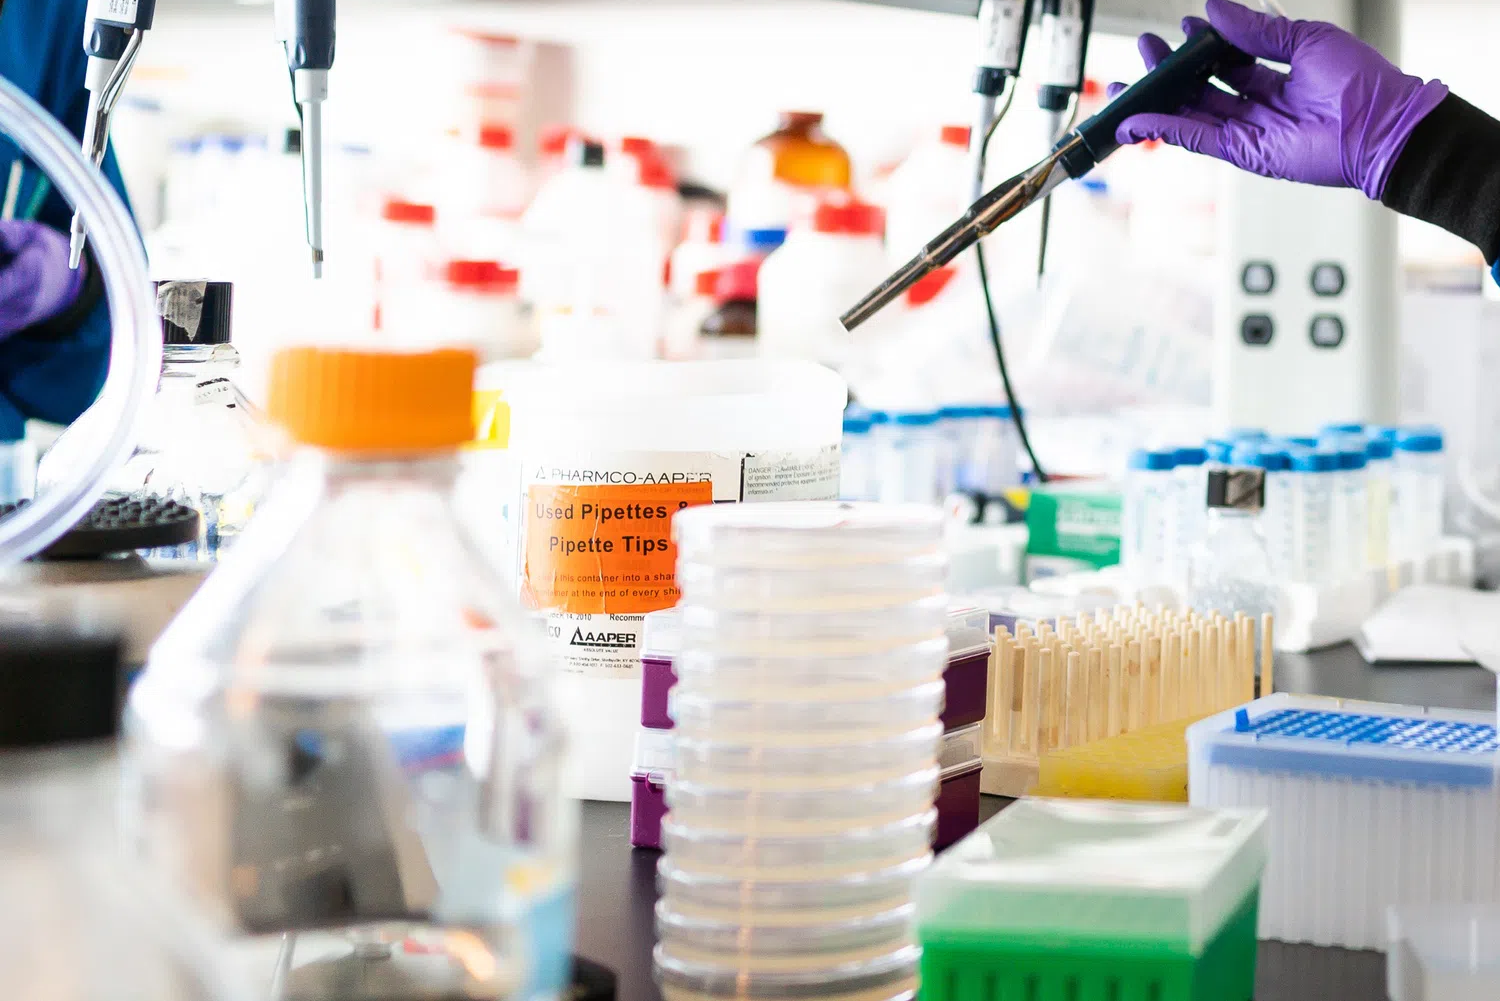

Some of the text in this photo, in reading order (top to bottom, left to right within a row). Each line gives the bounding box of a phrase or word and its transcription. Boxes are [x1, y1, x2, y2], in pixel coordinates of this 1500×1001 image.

[536, 503, 574, 520] Used
[581, 503, 667, 524] Pipettes
[549, 535, 668, 556] Pipette Tips
[560, 574, 575, 583] this
[577, 573, 619, 583] container
[622, 573, 640, 583] into
[644, 574, 650, 582] a
[571, 589, 580, 597] at
[582, 588, 596, 597] the
[599, 588, 616, 597] end
[619, 588, 629, 597] of
[632, 588, 660, 598] every
[576, 613, 592, 622] 2010
